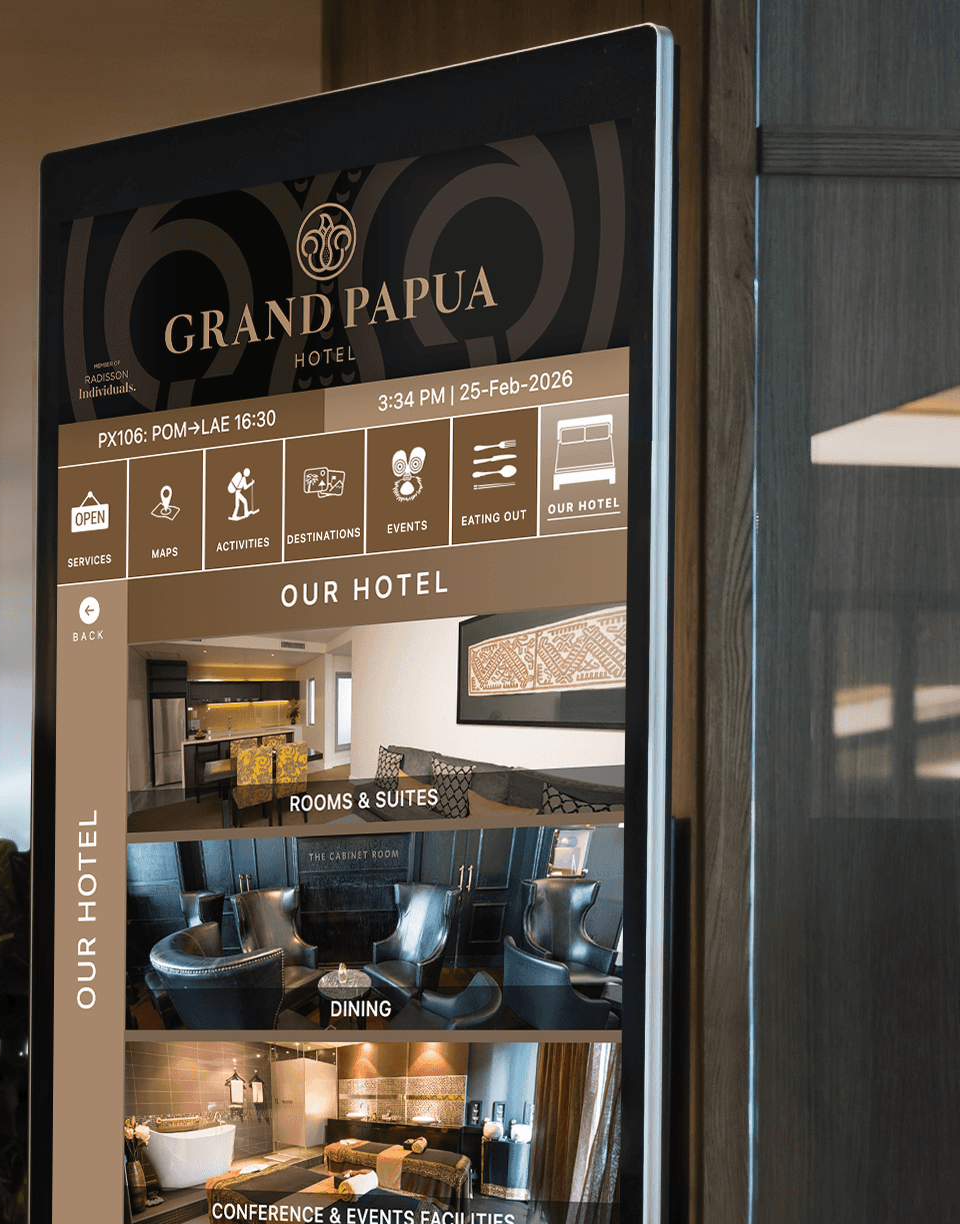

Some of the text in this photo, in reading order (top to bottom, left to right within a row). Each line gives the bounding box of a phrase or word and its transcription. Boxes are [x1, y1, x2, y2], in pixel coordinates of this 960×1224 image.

[164, 265, 498, 354] GRAND PAPUA
[93, 361, 113, 369] MEMBER
[294, 345, 357, 369] HOTEL
[85, 369, 129, 384] RADISSON
[79, 382, 137, 400] Individuals.
[378, 391, 414, 412] 3:34
[420, 387, 445, 406] PM
[460, 369, 573, 402] 25-Feb-2026
[98, 428, 147, 448] PX106:
[234, 409, 276, 430] 16:30
[548, 497, 620, 515] OUR HOTEL
[75, 509, 106, 527] OPEN
[461, 509, 527, 526] EATING OUT
[387, 520, 428, 534] EVENTS
[216, 537, 270, 552] ACTIVITIES
[287, 528, 361, 545] DESTINATIONS
[67, 554, 112, 568] SERVICES
[151, 547, 178, 559] MAPS
[281, 570, 448, 607] OUR HOTEL
[73, 630, 104, 642] BACK
[290, 789, 439, 812] ROOMS & SUITES
[308, 850, 399, 862] THE CABINET ROOM
[76, 810, 98, 1010] OUR HOTEL
[330, 1000, 392, 1017] DINING
[212, 1203, 324, 1224] CONFERENCE
[330, 1207, 341, 1224] &
